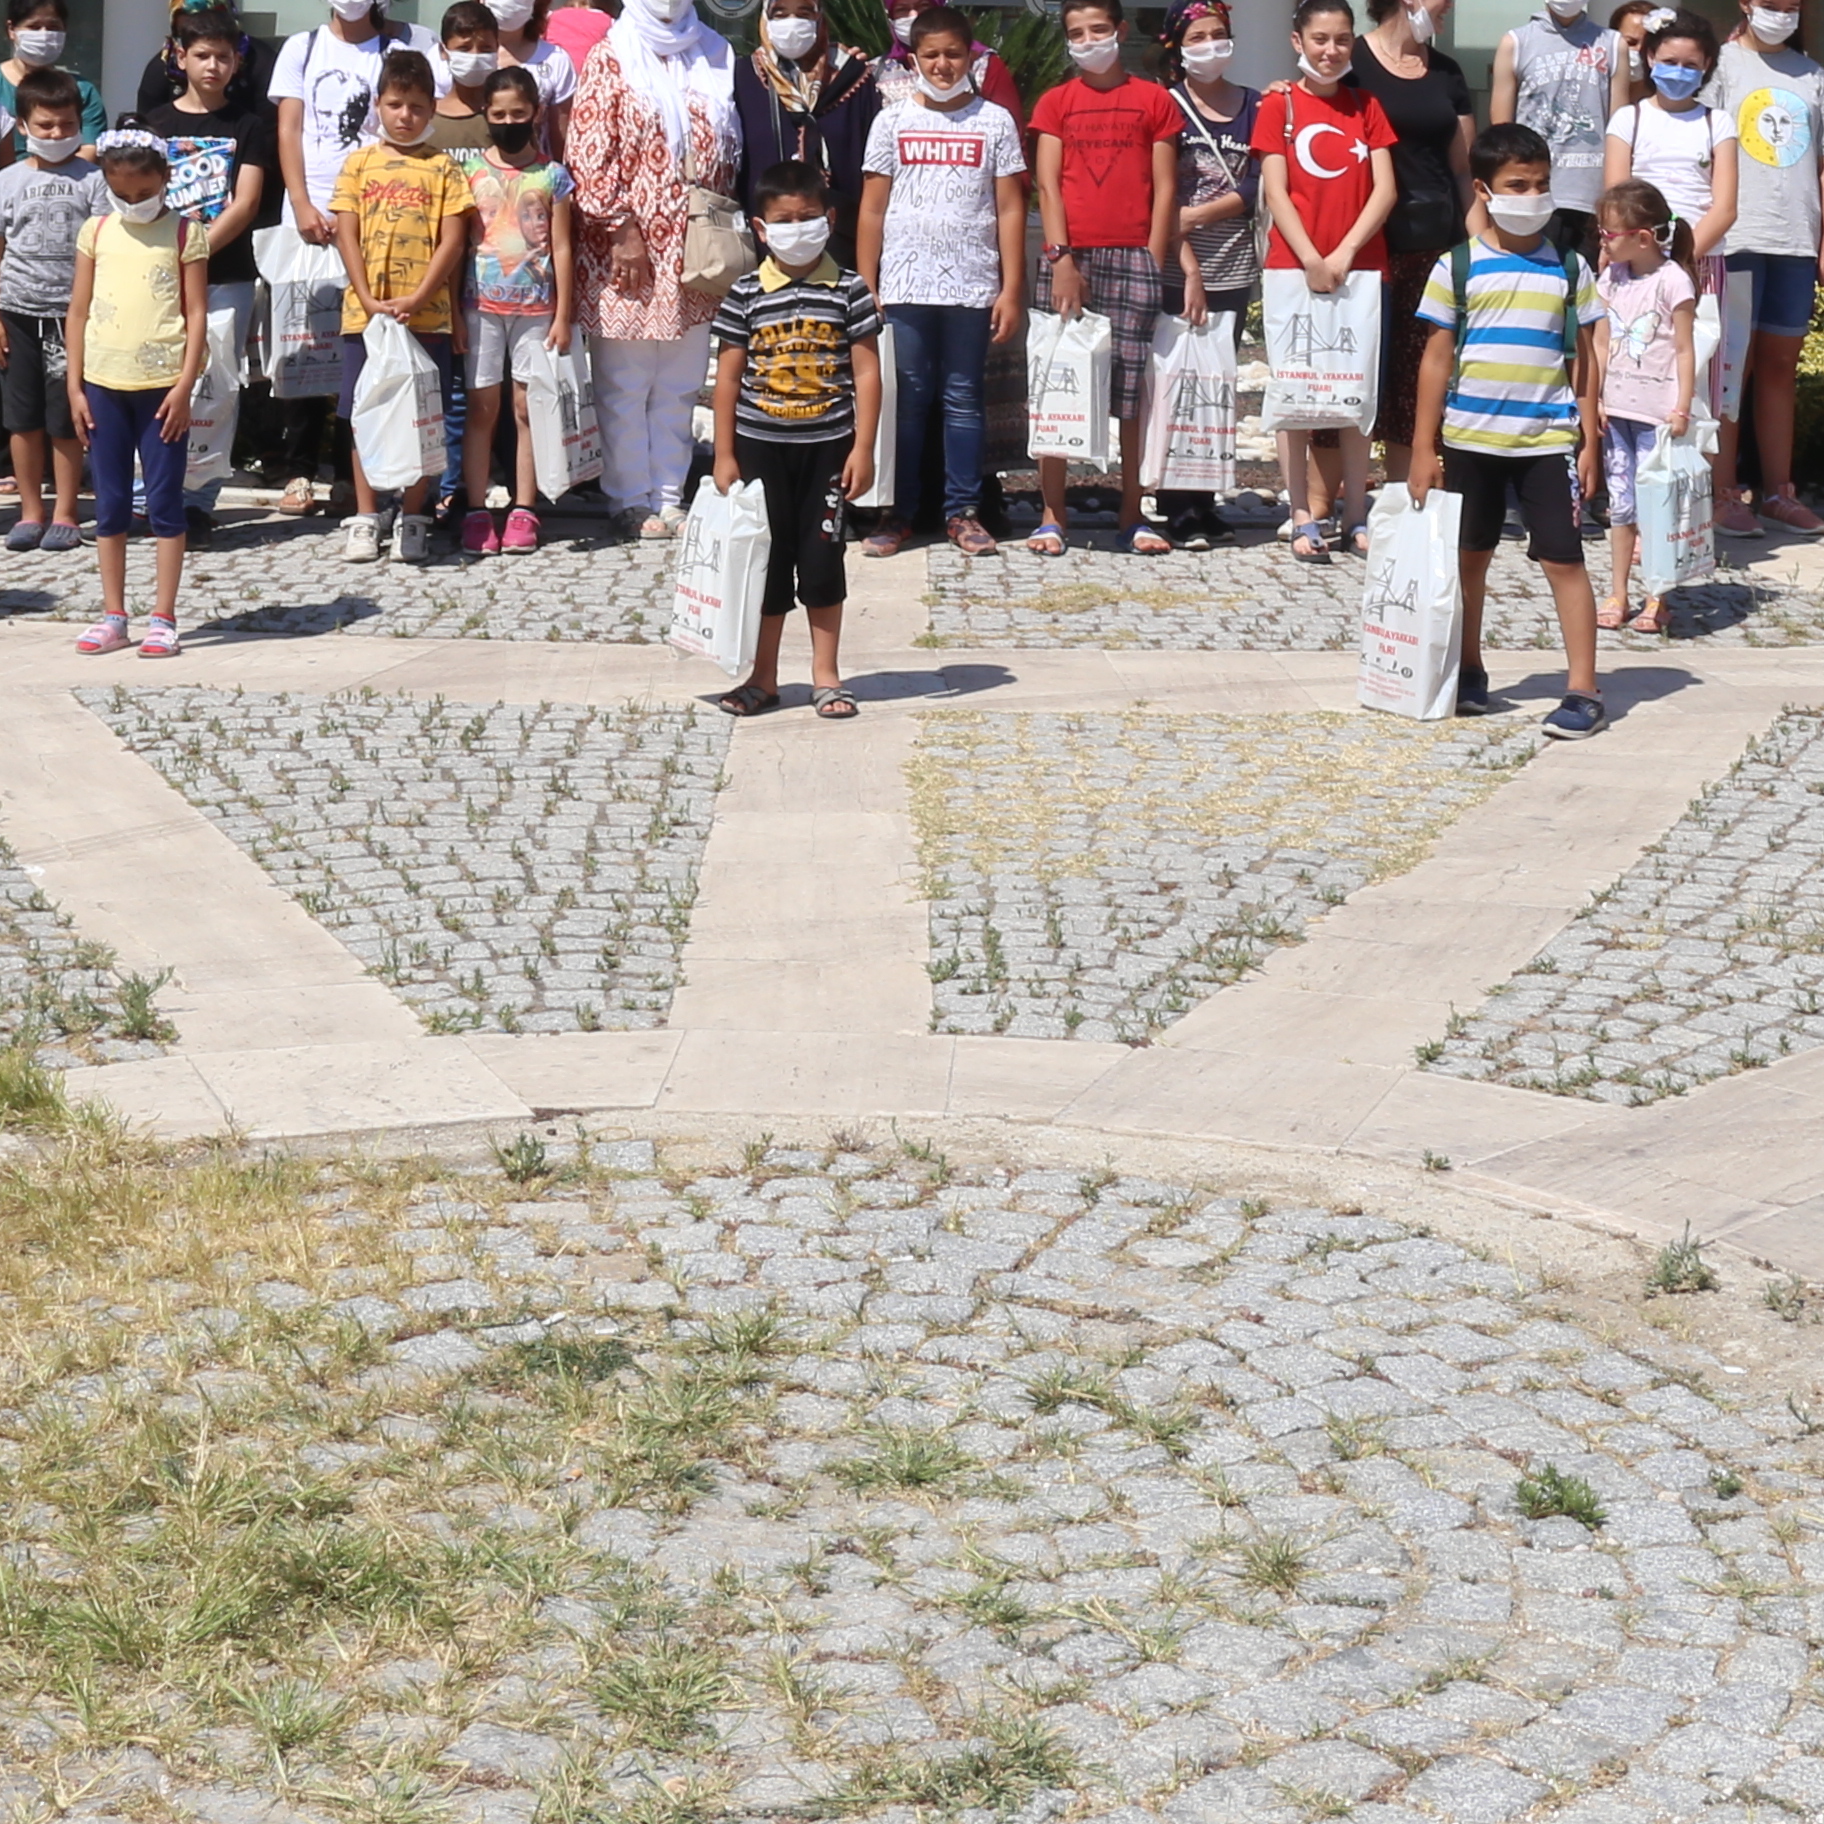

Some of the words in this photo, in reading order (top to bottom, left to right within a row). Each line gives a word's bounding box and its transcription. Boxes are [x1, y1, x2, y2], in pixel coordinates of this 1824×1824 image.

[903, 140, 976, 163] WHITE
[21, 182, 74, 201] ARIZONA
[1277, 370, 1319, 381] İSTANBUL
[1307, 384, 1332, 393] FUARI
[1047, 413, 1085, 422] AYAKKABI
[1036, 424, 1058, 433] FUARI
[1188, 436, 1212, 446] FUARI
